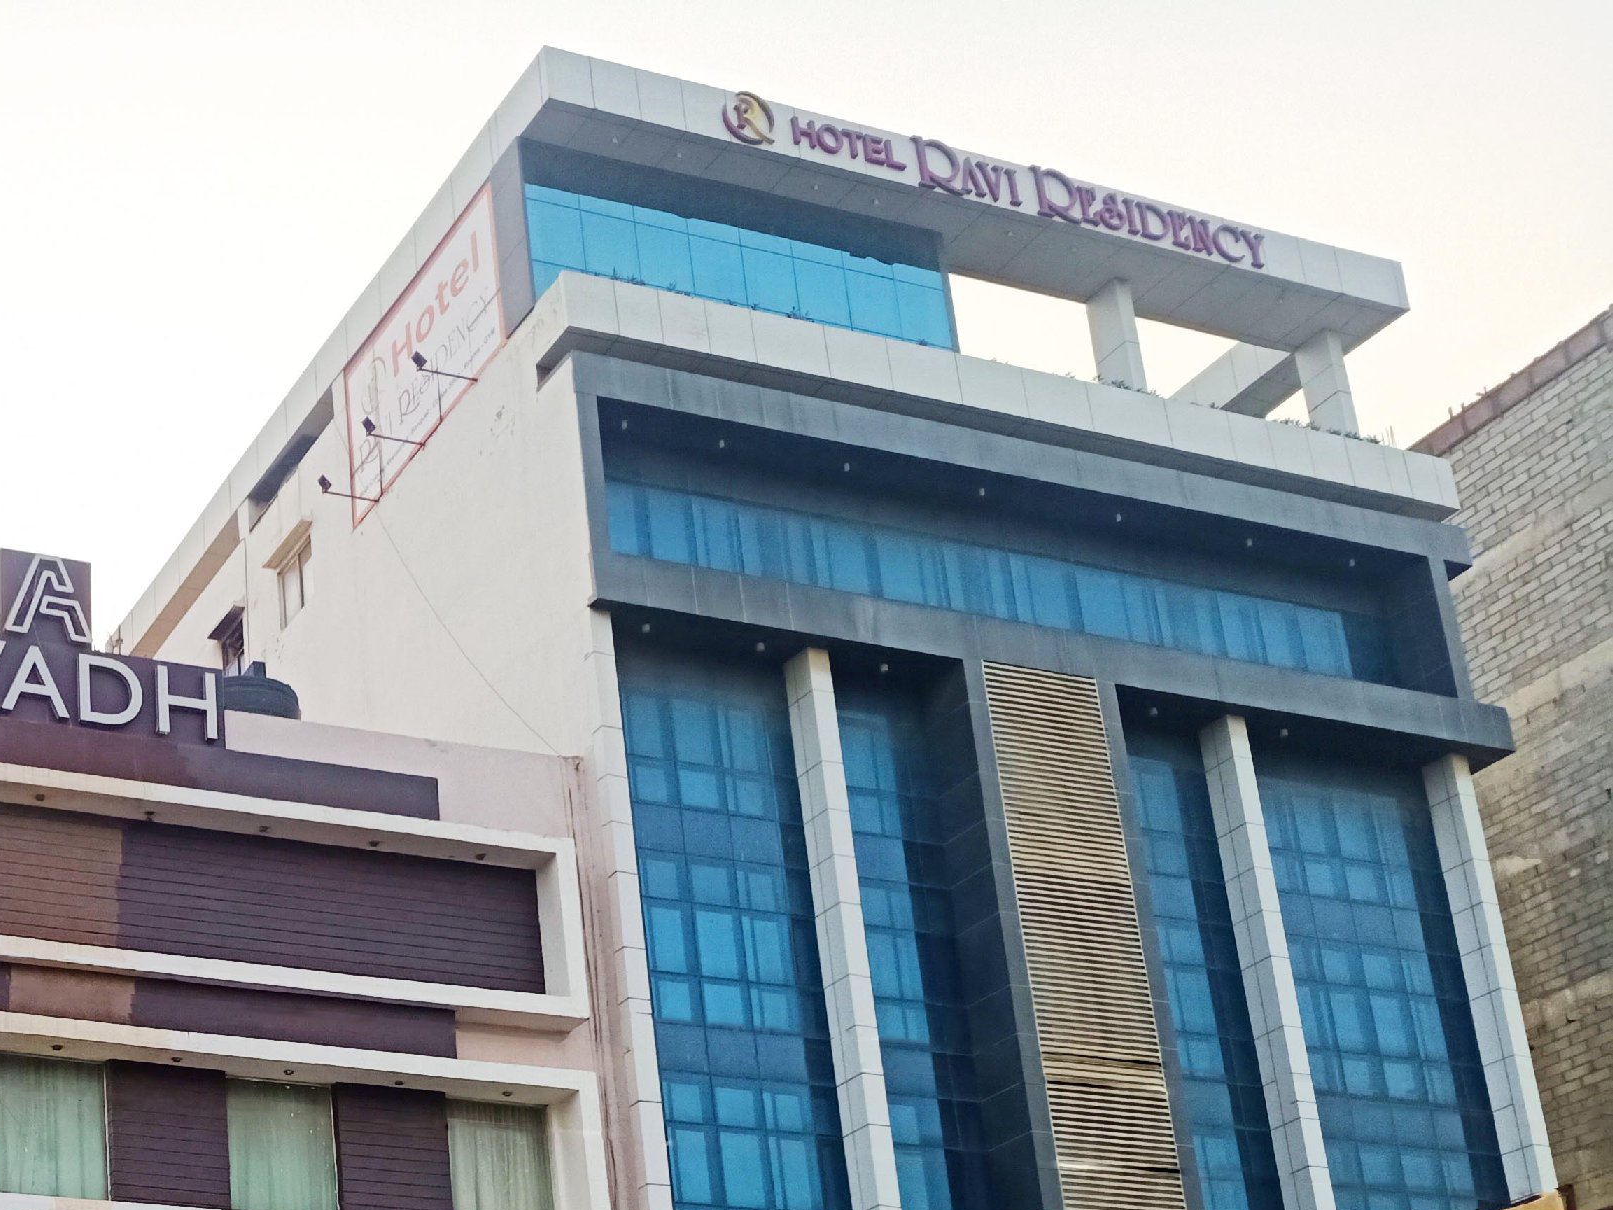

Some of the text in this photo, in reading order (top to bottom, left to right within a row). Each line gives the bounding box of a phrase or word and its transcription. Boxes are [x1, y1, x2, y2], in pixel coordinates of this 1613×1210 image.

[790, 116, 1266, 269] HOTEL RAVI RESIDENCY
[391, 231, 479, 377] Hotel
